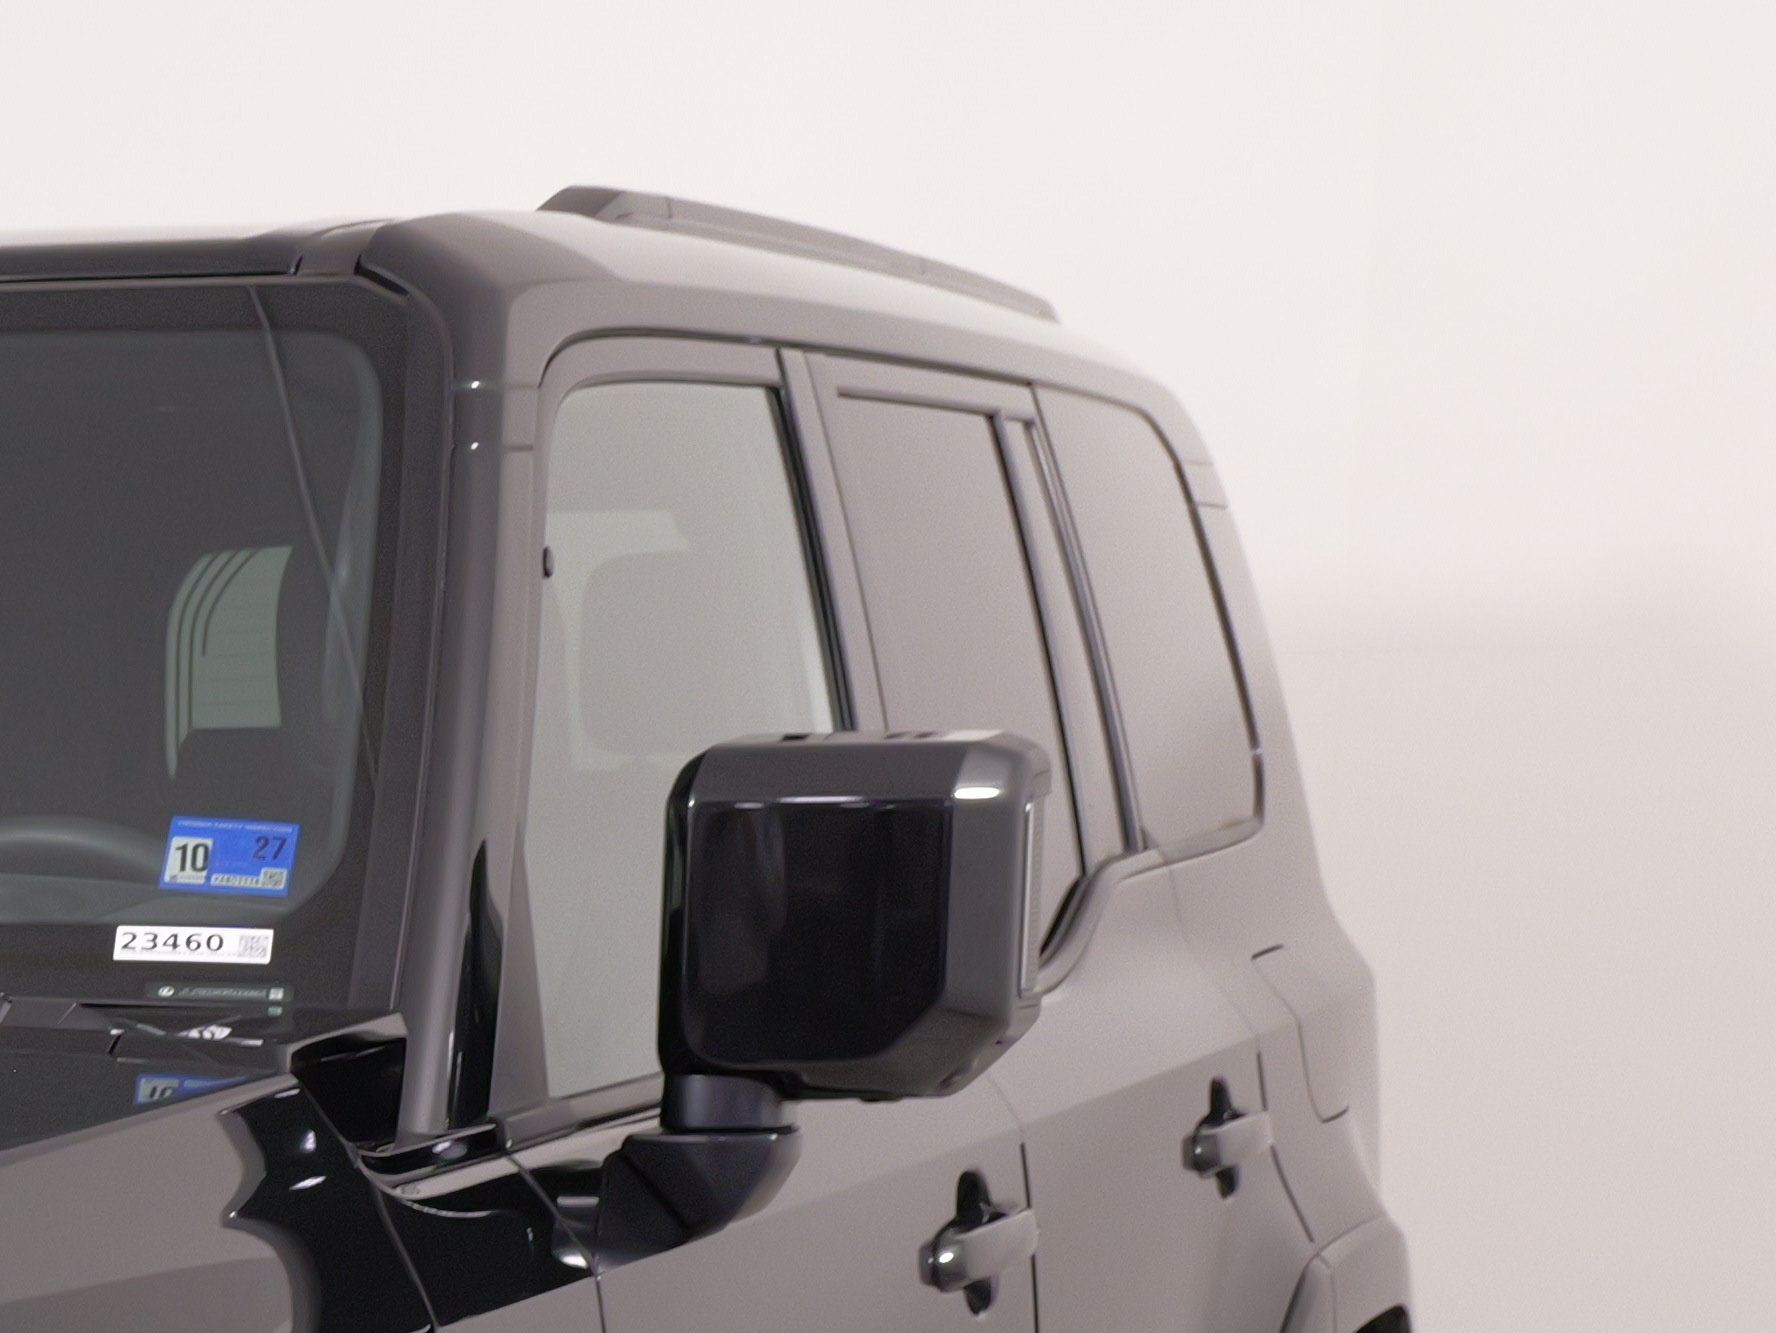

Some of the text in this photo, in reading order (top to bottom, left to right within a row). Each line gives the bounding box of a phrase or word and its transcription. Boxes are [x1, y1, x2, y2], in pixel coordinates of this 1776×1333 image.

[175, 843, 210, 872] 10
[253, 836, 288, 861] 27
[121, 932, 224, 952] 23460
